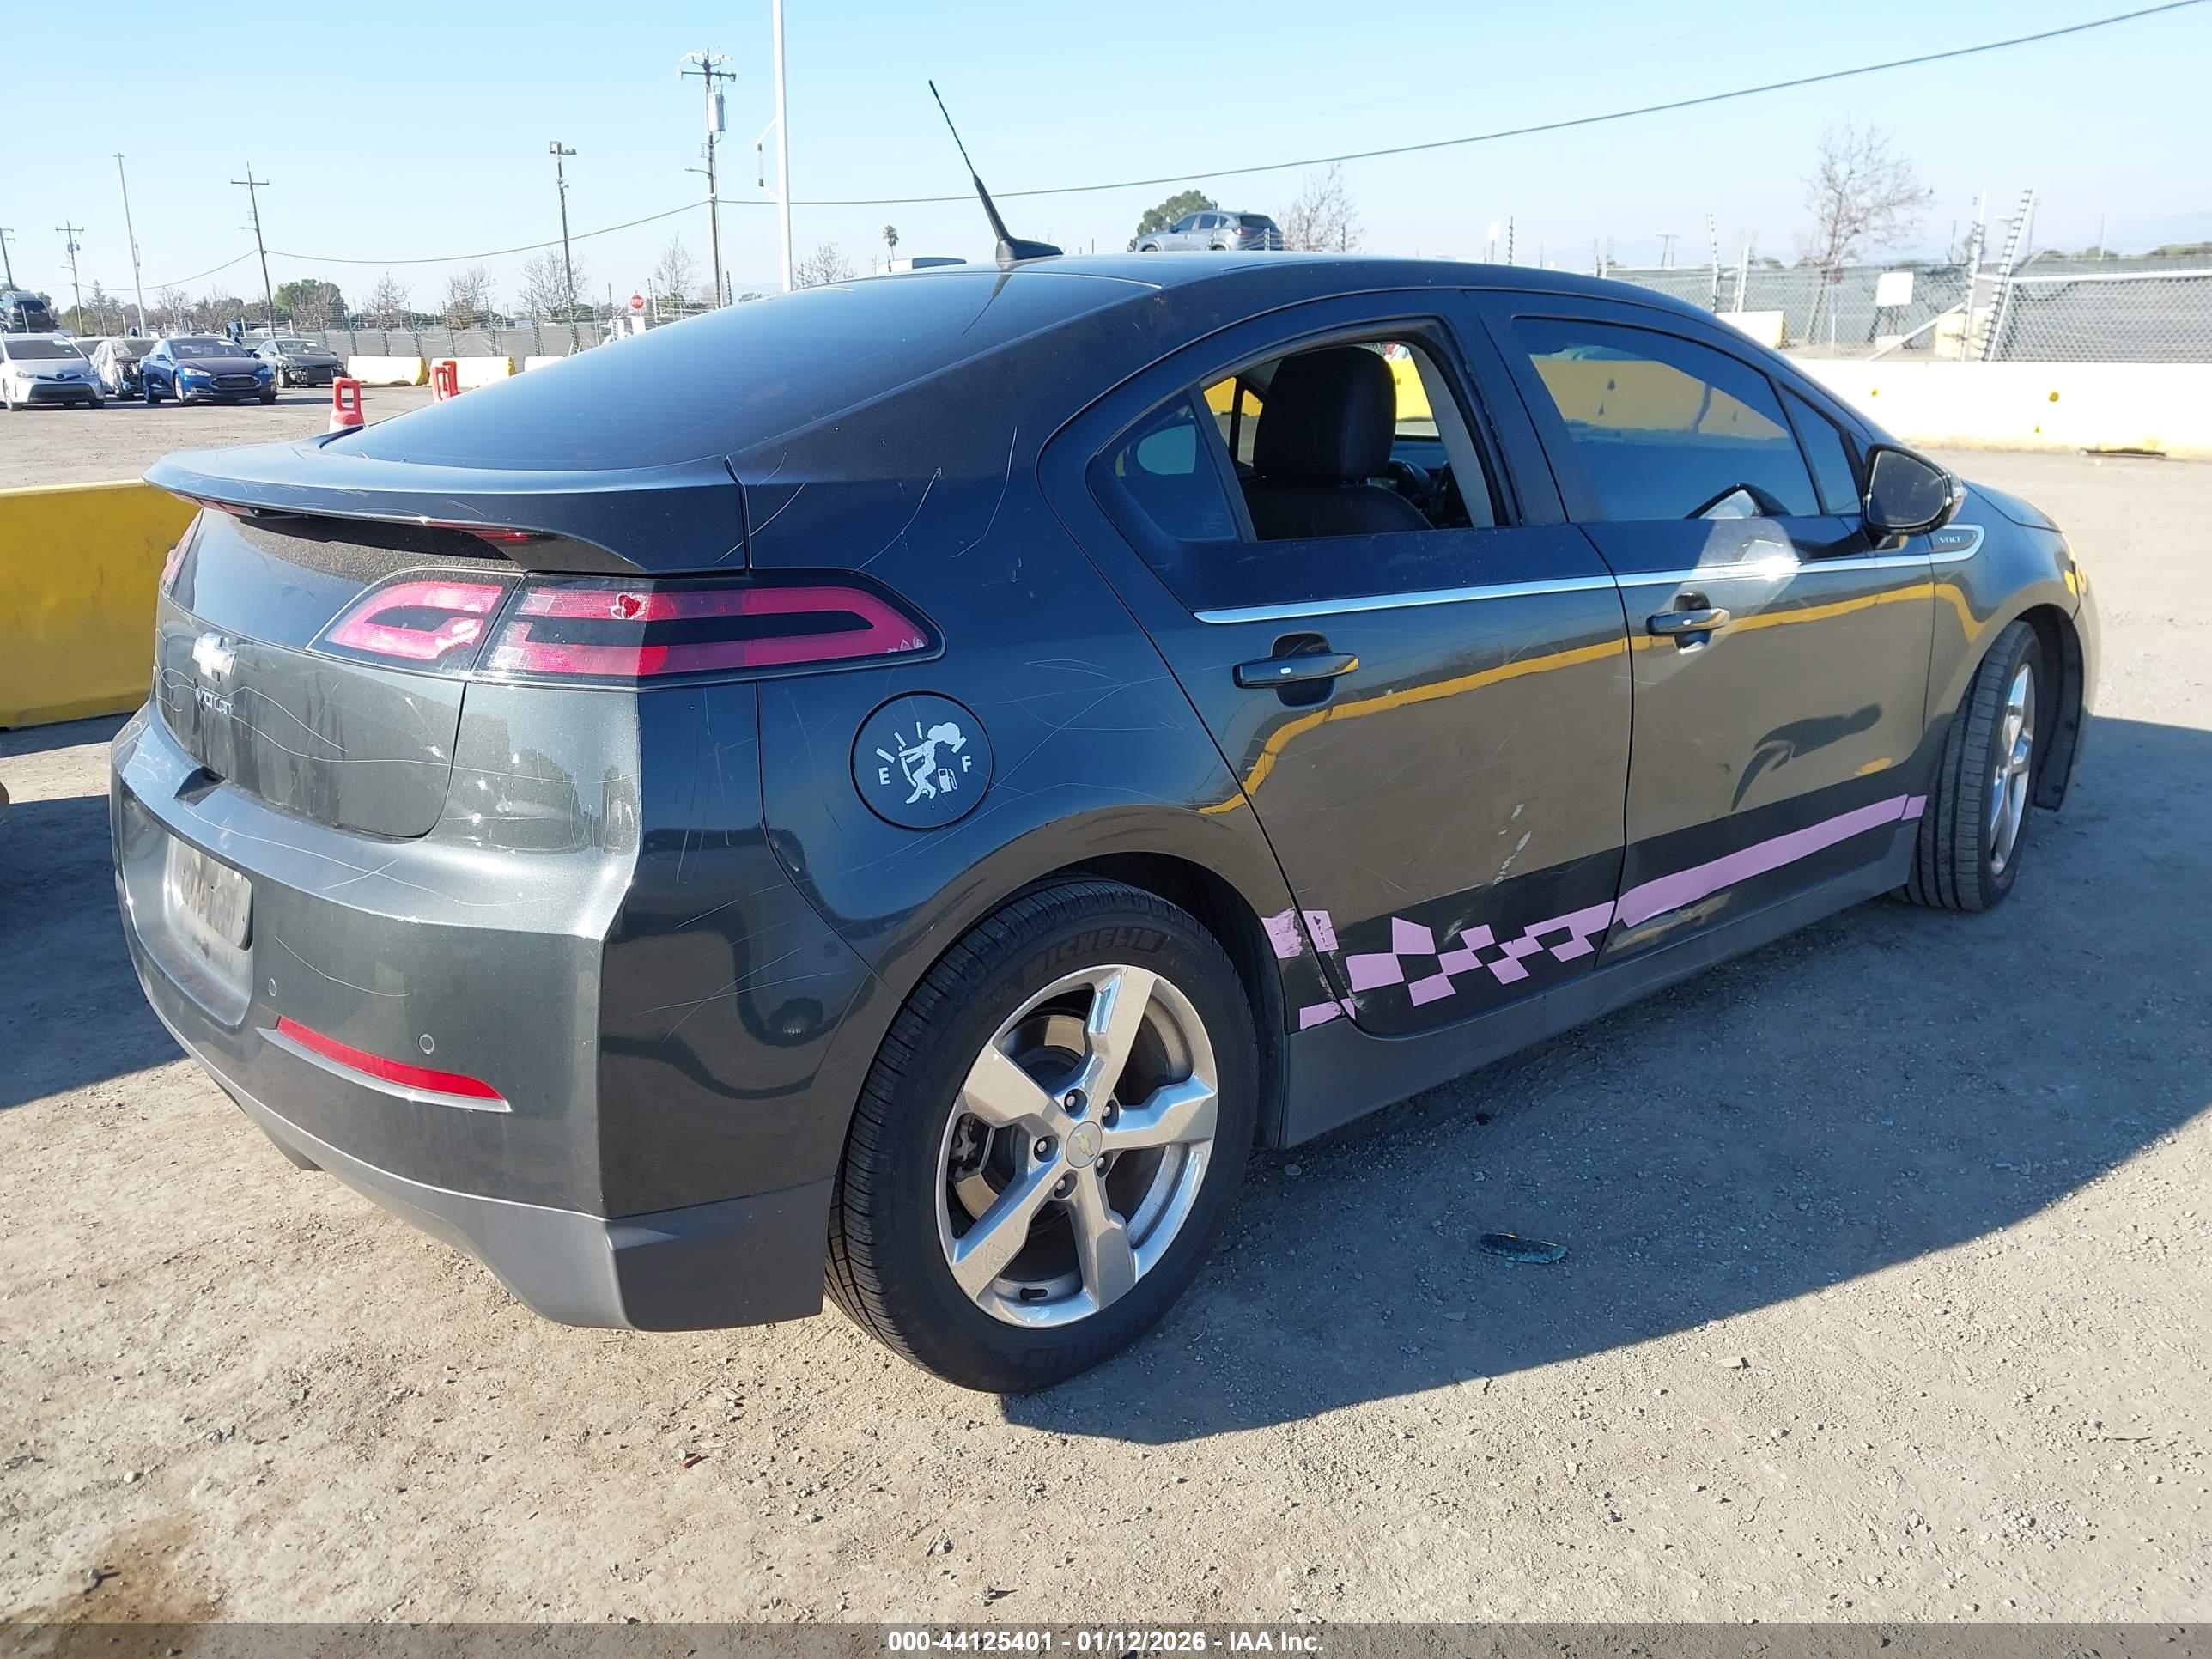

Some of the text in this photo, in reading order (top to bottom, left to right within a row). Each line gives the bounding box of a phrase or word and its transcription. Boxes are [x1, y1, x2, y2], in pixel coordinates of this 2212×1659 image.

[195, 687, 234, 715] VOLT
[961, 755, 972, 773] F
[878, 767, 891, 786] E
[1022, 927, 1164, 984] MICHELIN
